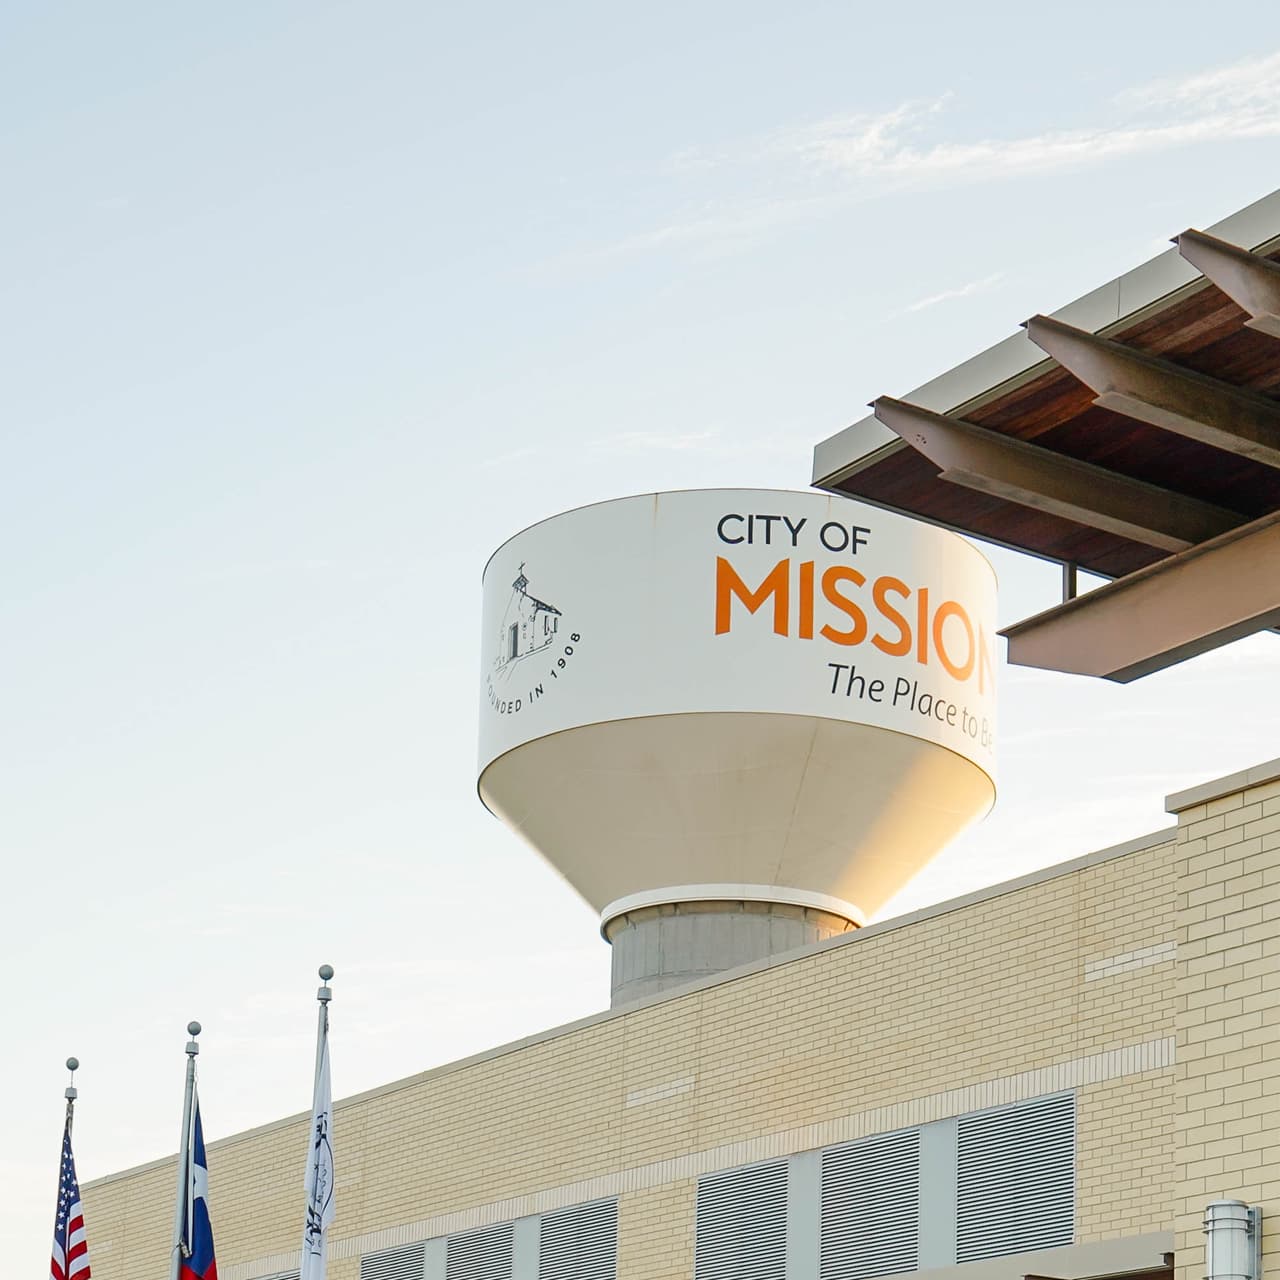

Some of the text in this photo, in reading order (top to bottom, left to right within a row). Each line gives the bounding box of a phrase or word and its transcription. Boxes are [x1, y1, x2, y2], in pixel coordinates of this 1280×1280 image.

[717, 513, 871, 555] CITY OF
[528, 683, 544, 704] IN
[550, 633, 581, 679] 1908
[828, 662, 885, 703] The
[892, 677, 958, 727] Place
[962, 706, 978, 739] to
